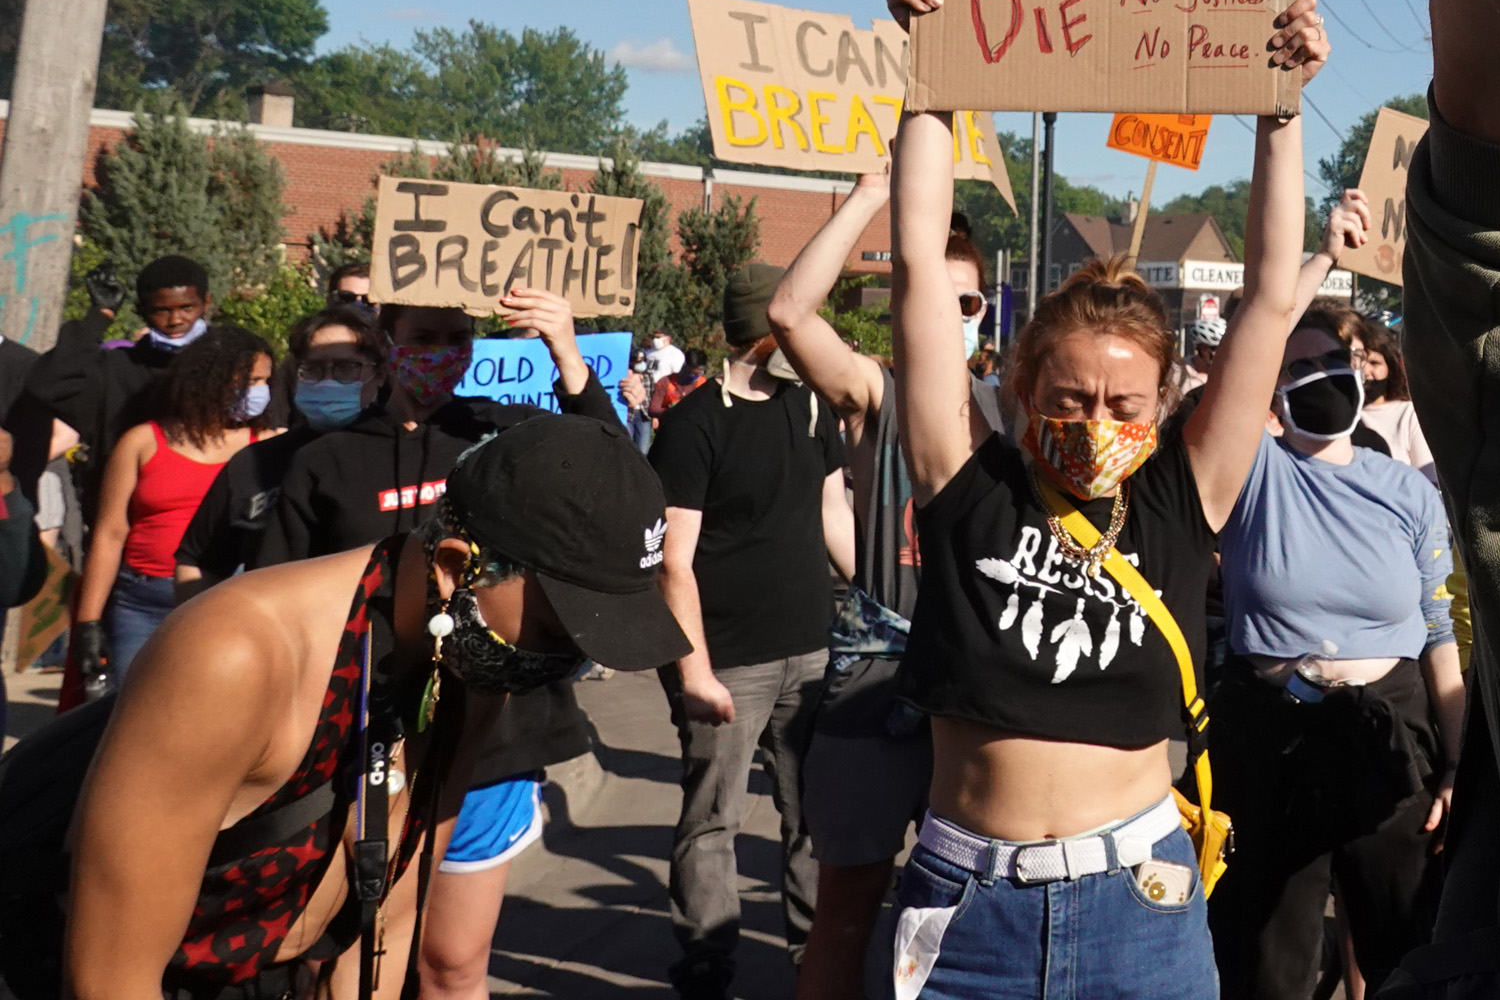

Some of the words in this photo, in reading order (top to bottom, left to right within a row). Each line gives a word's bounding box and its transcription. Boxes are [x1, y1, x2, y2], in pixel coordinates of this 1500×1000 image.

[728, 11, 775, 73] I
[1135, 27, 1170, 60] No
[1114, 115, 1208, 165] CONSENT
[394, 181, 449, 232] I
[480, 190, 606, 248] Can't
[388, 223, 637, 307] BREATHE!
[1192, 267, 1244, 284] CLEANE
[461, 356, 534, 389] OLD
